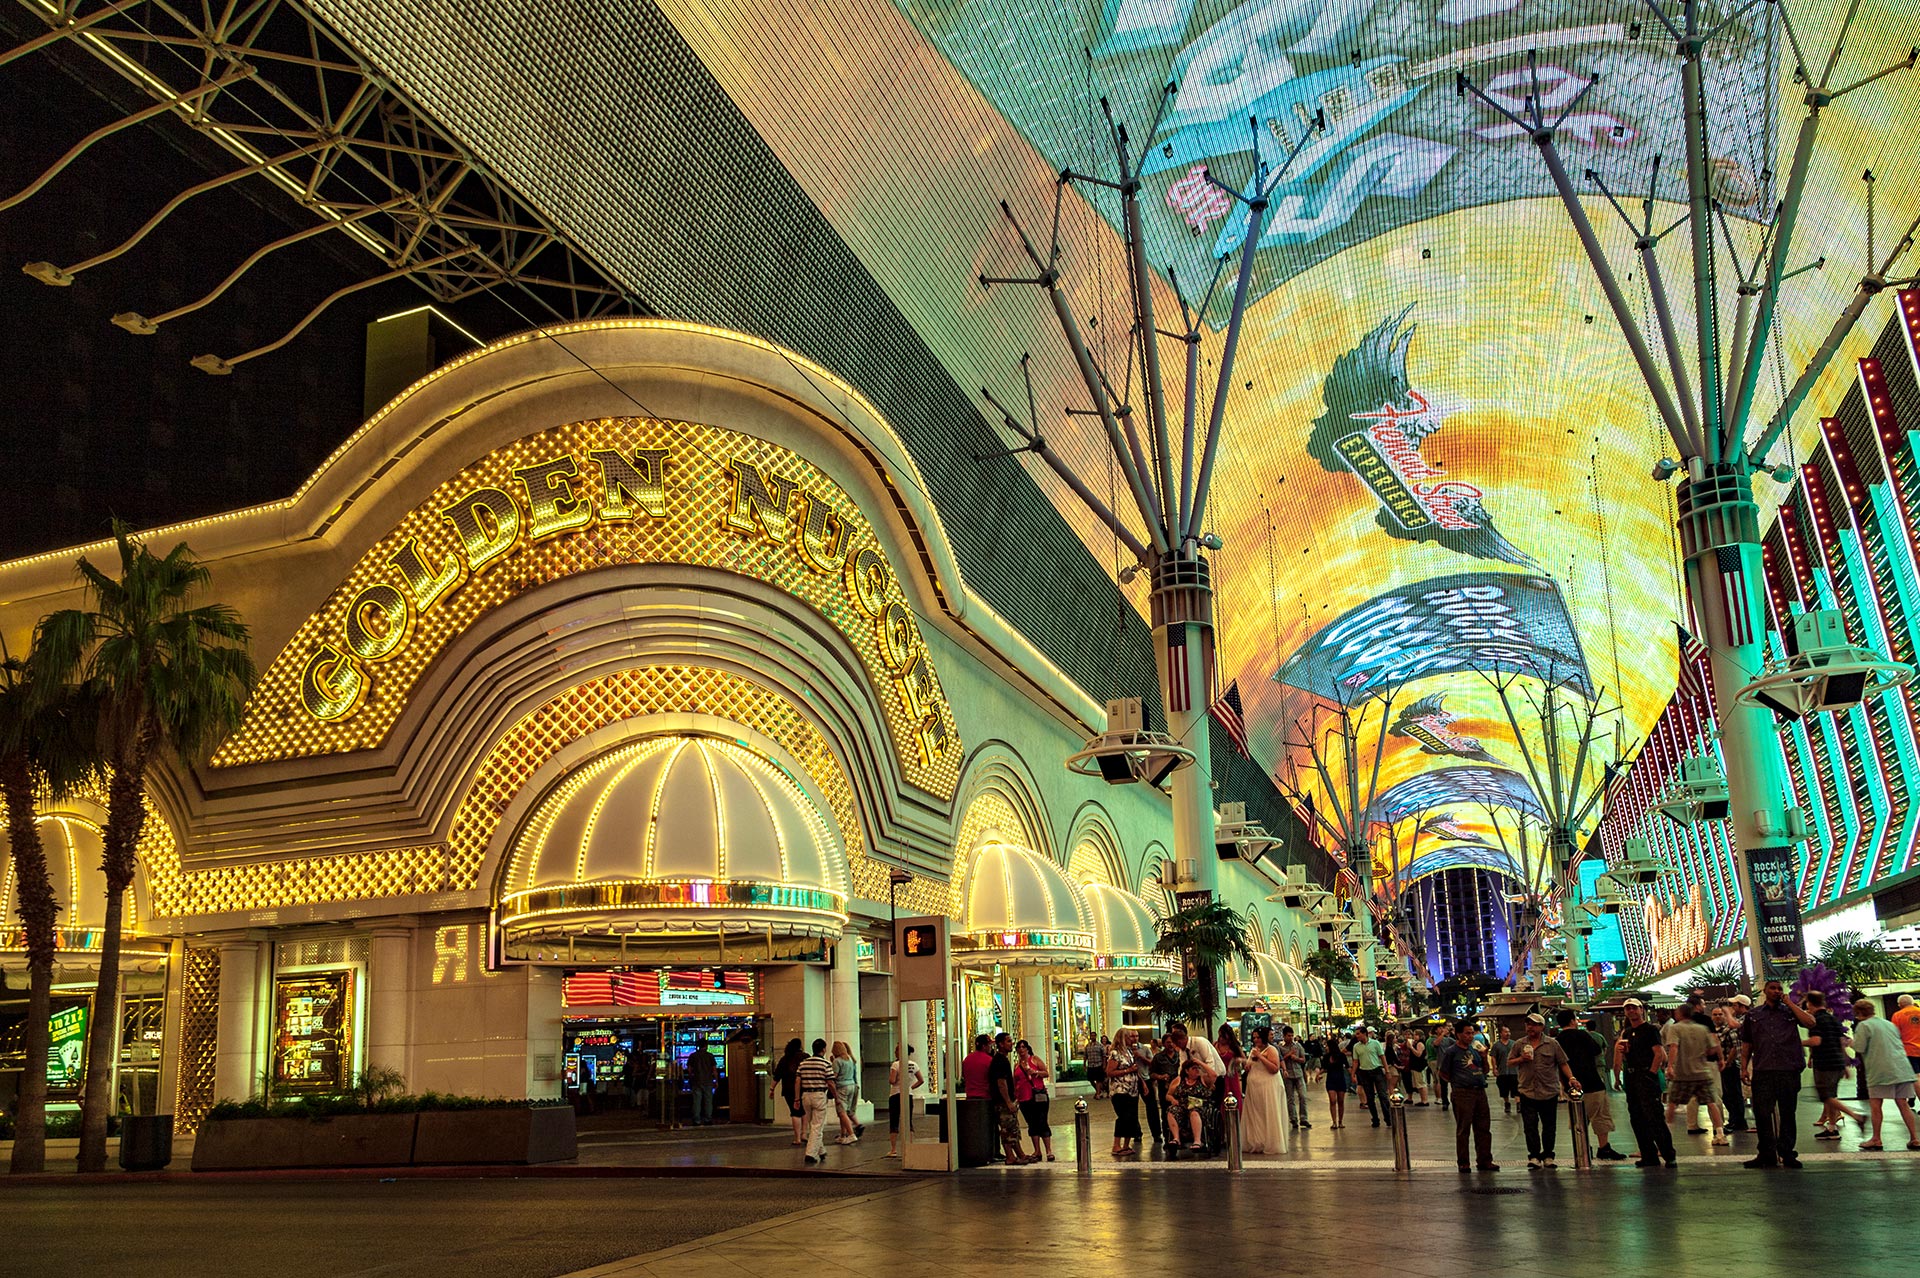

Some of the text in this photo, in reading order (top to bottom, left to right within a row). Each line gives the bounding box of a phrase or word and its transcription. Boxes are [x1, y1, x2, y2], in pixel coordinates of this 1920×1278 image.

[1348, 388, 1483, 531] Fremont Street
[1341, 435, 1427, 527] EXPERIENCE
[300, 448, 950, 766] GOLDEN NUGGET
[1753, 861, 1777, 872] ROCK
[1769, 916, 1787, 924] FREE
[1763, 924, 1796, 934] CONCERTS
[1767, 934, 1795, 943] NIGHTLY
[64, 1014, 70, 1026] 2
[77, 1009, 83, 1021] 2
